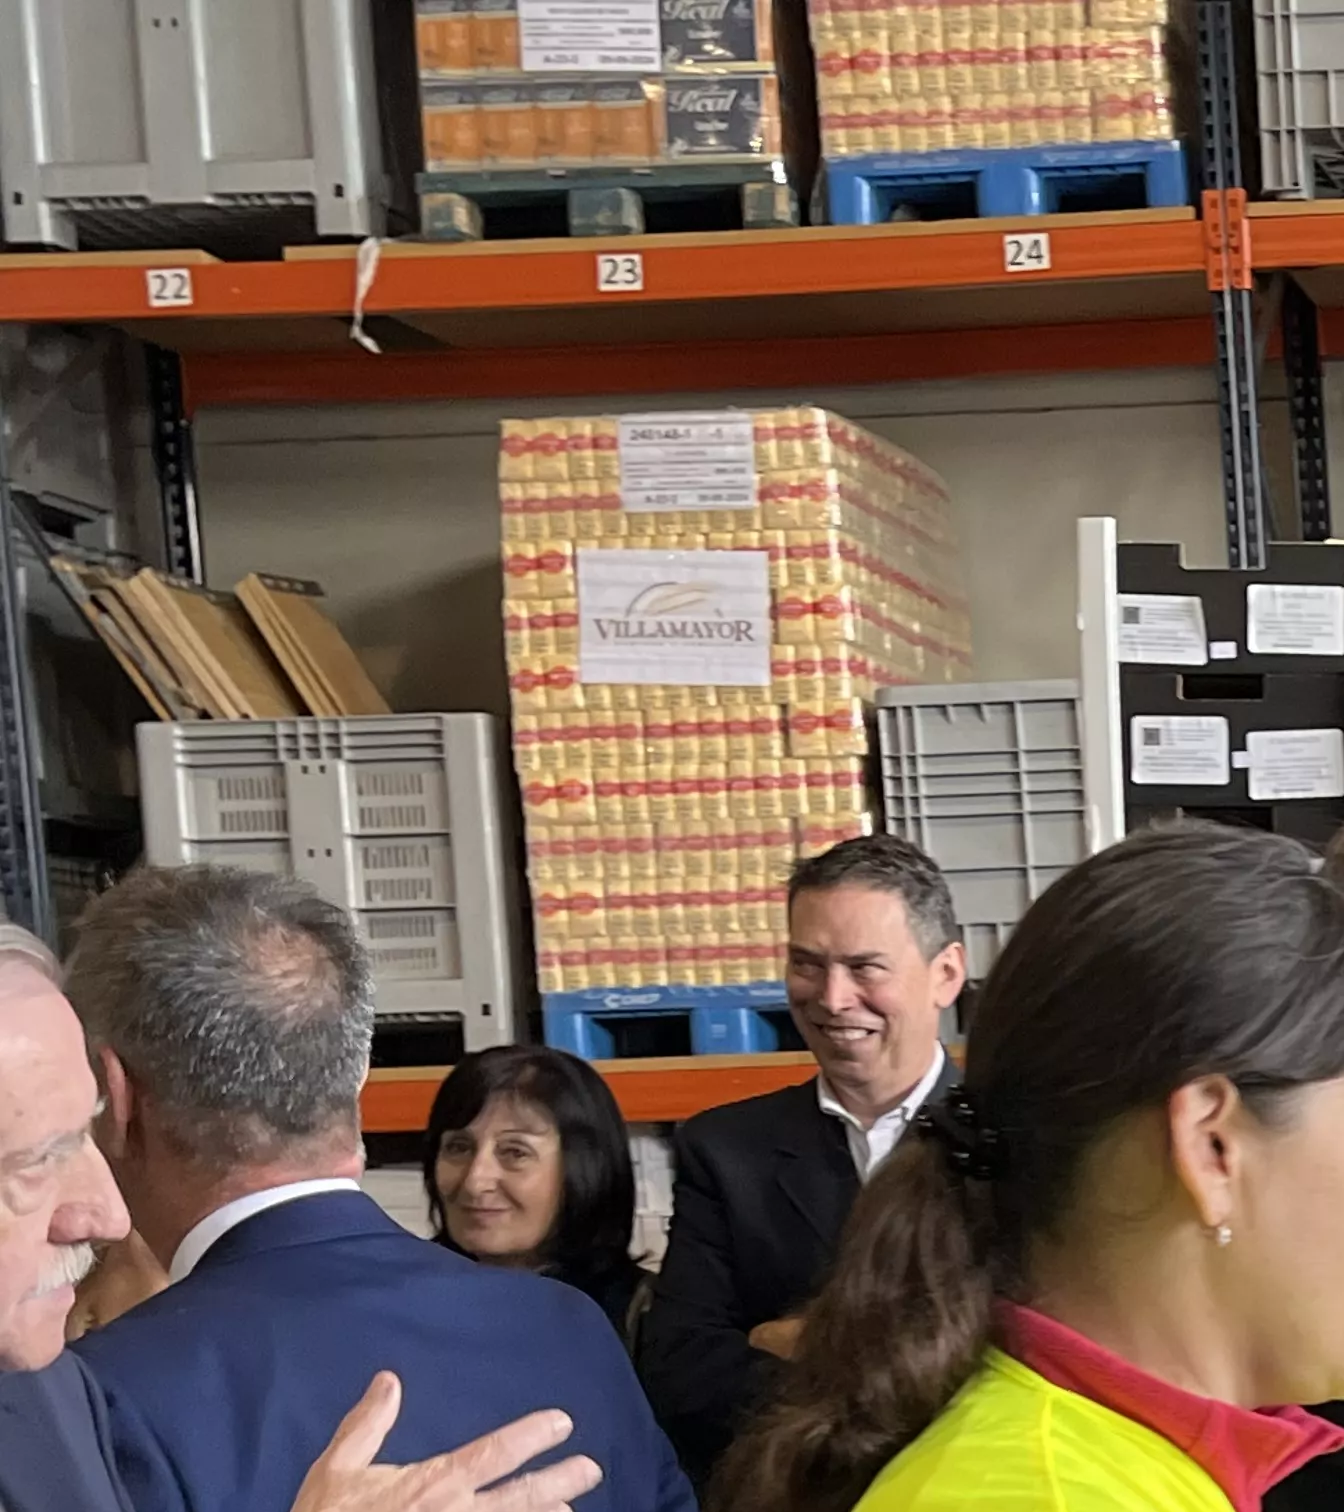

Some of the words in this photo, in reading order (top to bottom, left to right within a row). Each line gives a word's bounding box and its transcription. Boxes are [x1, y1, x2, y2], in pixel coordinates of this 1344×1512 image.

[1007, 239, 1044, 266] 24
[603, 258, 640, 284] 23
[152, 273, 188, 300] 22
[593, 618, 755, 642] VILLAMAYOR
